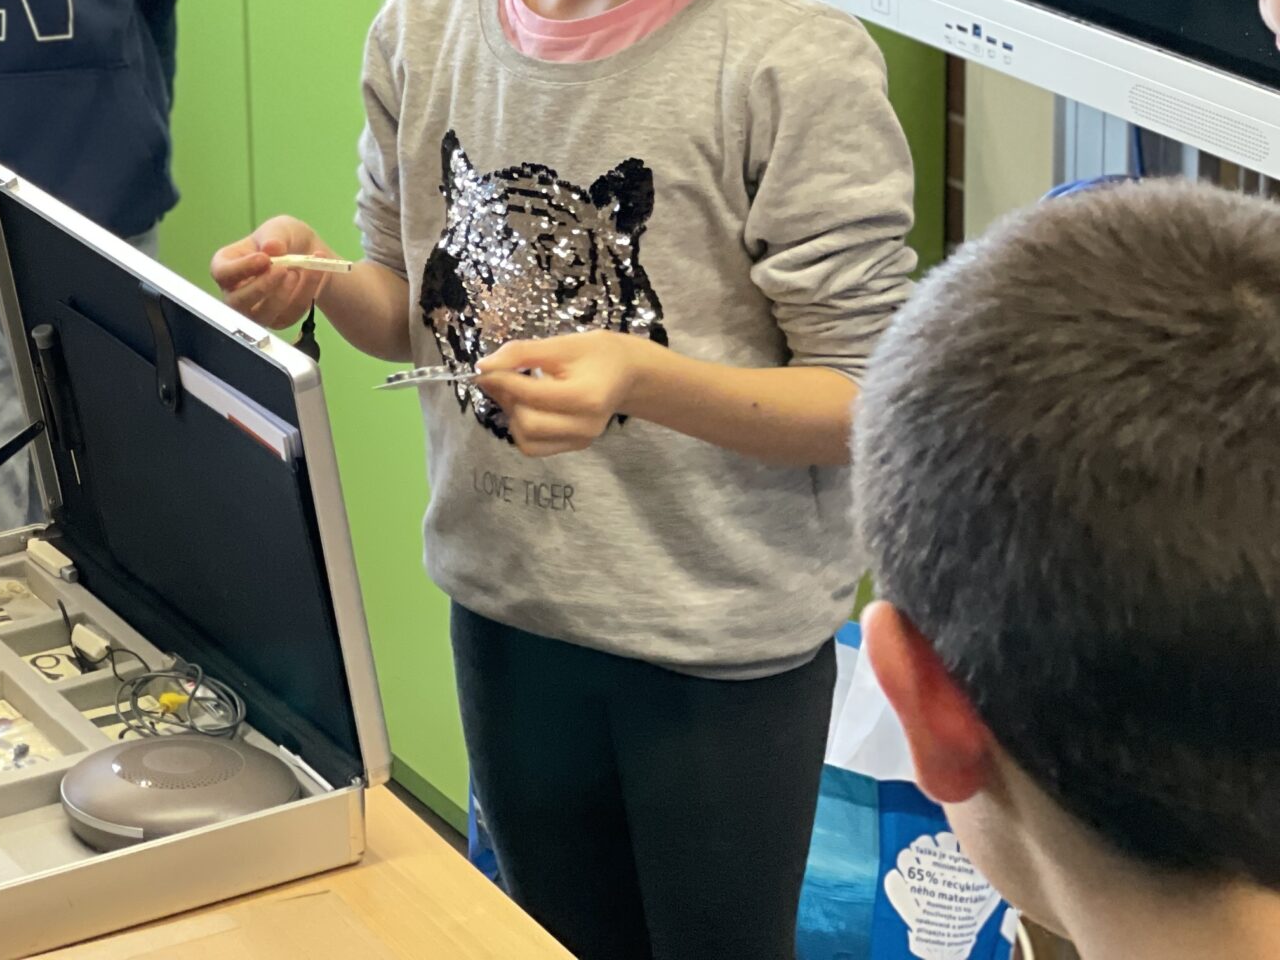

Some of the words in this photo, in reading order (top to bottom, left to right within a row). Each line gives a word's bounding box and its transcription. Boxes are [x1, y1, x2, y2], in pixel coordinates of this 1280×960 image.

[473, 469, 513, 503] LOVE
[522, 480, 576, 512] TIGER
[907, 866, 939, 885] 65%
